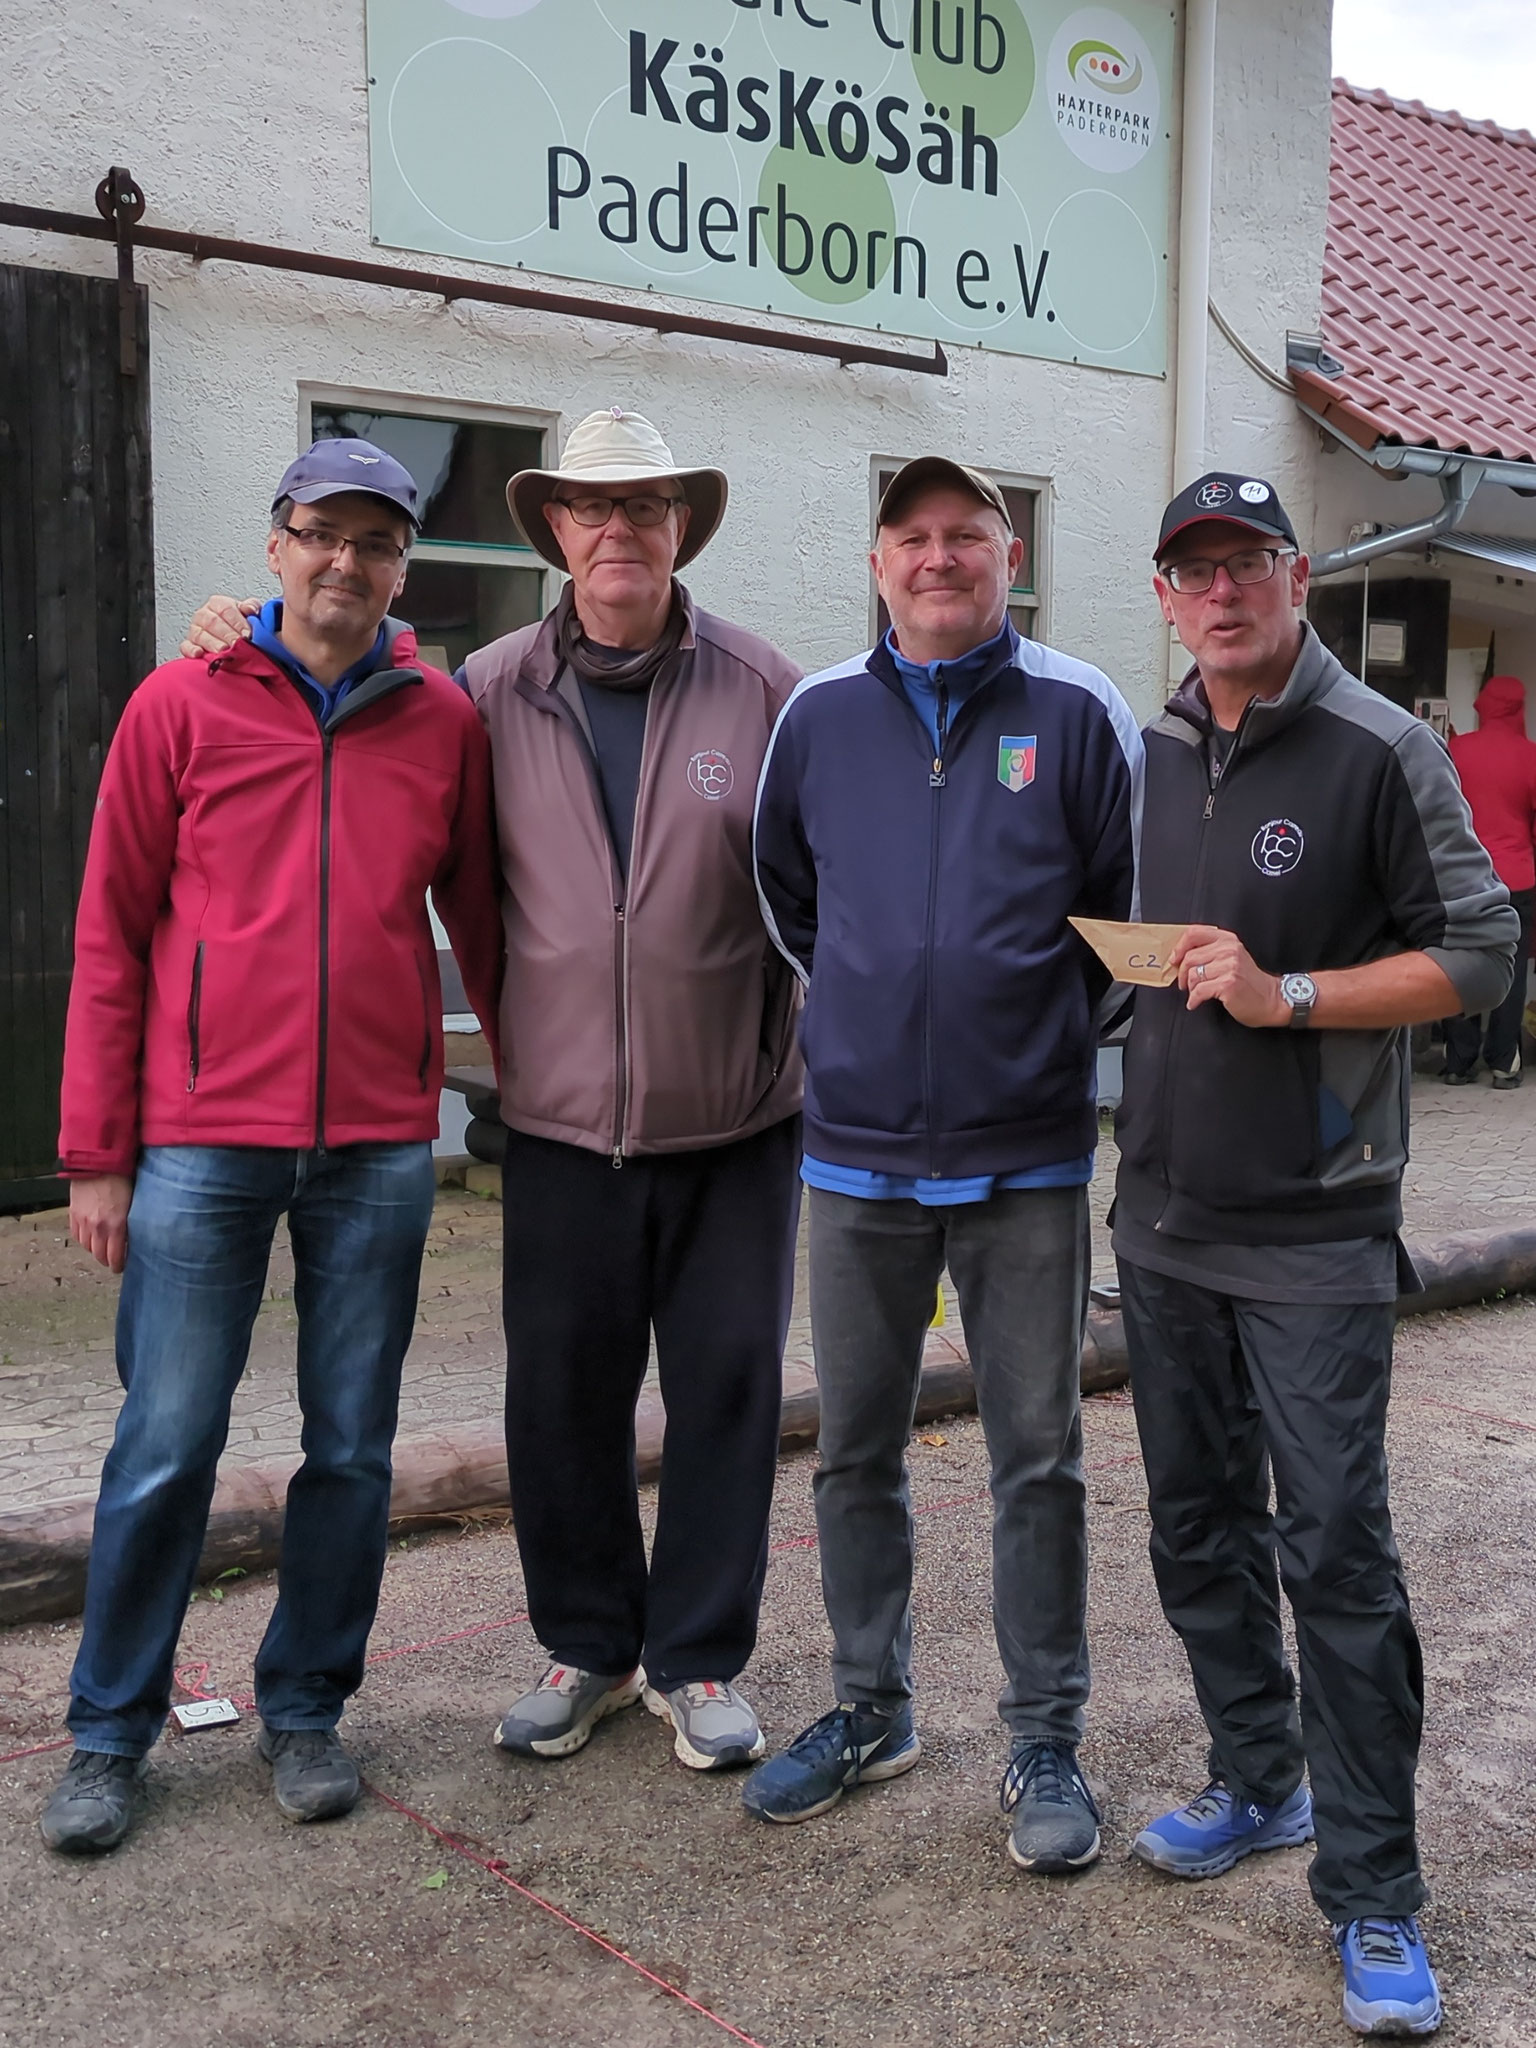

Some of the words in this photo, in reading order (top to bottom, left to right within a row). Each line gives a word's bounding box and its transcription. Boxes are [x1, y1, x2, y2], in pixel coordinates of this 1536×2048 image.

[629, 30, 998, 197] KäsKöSäh
[1057, 92, 1151, 131] HAXTERPARK
[1057, 110, 1151, 147] PADERBORN
[547, 146, 926, 299] Paderborn
[956, 243, 1056, 323] e.V.
[1128, 954, 1161, 969] C2
